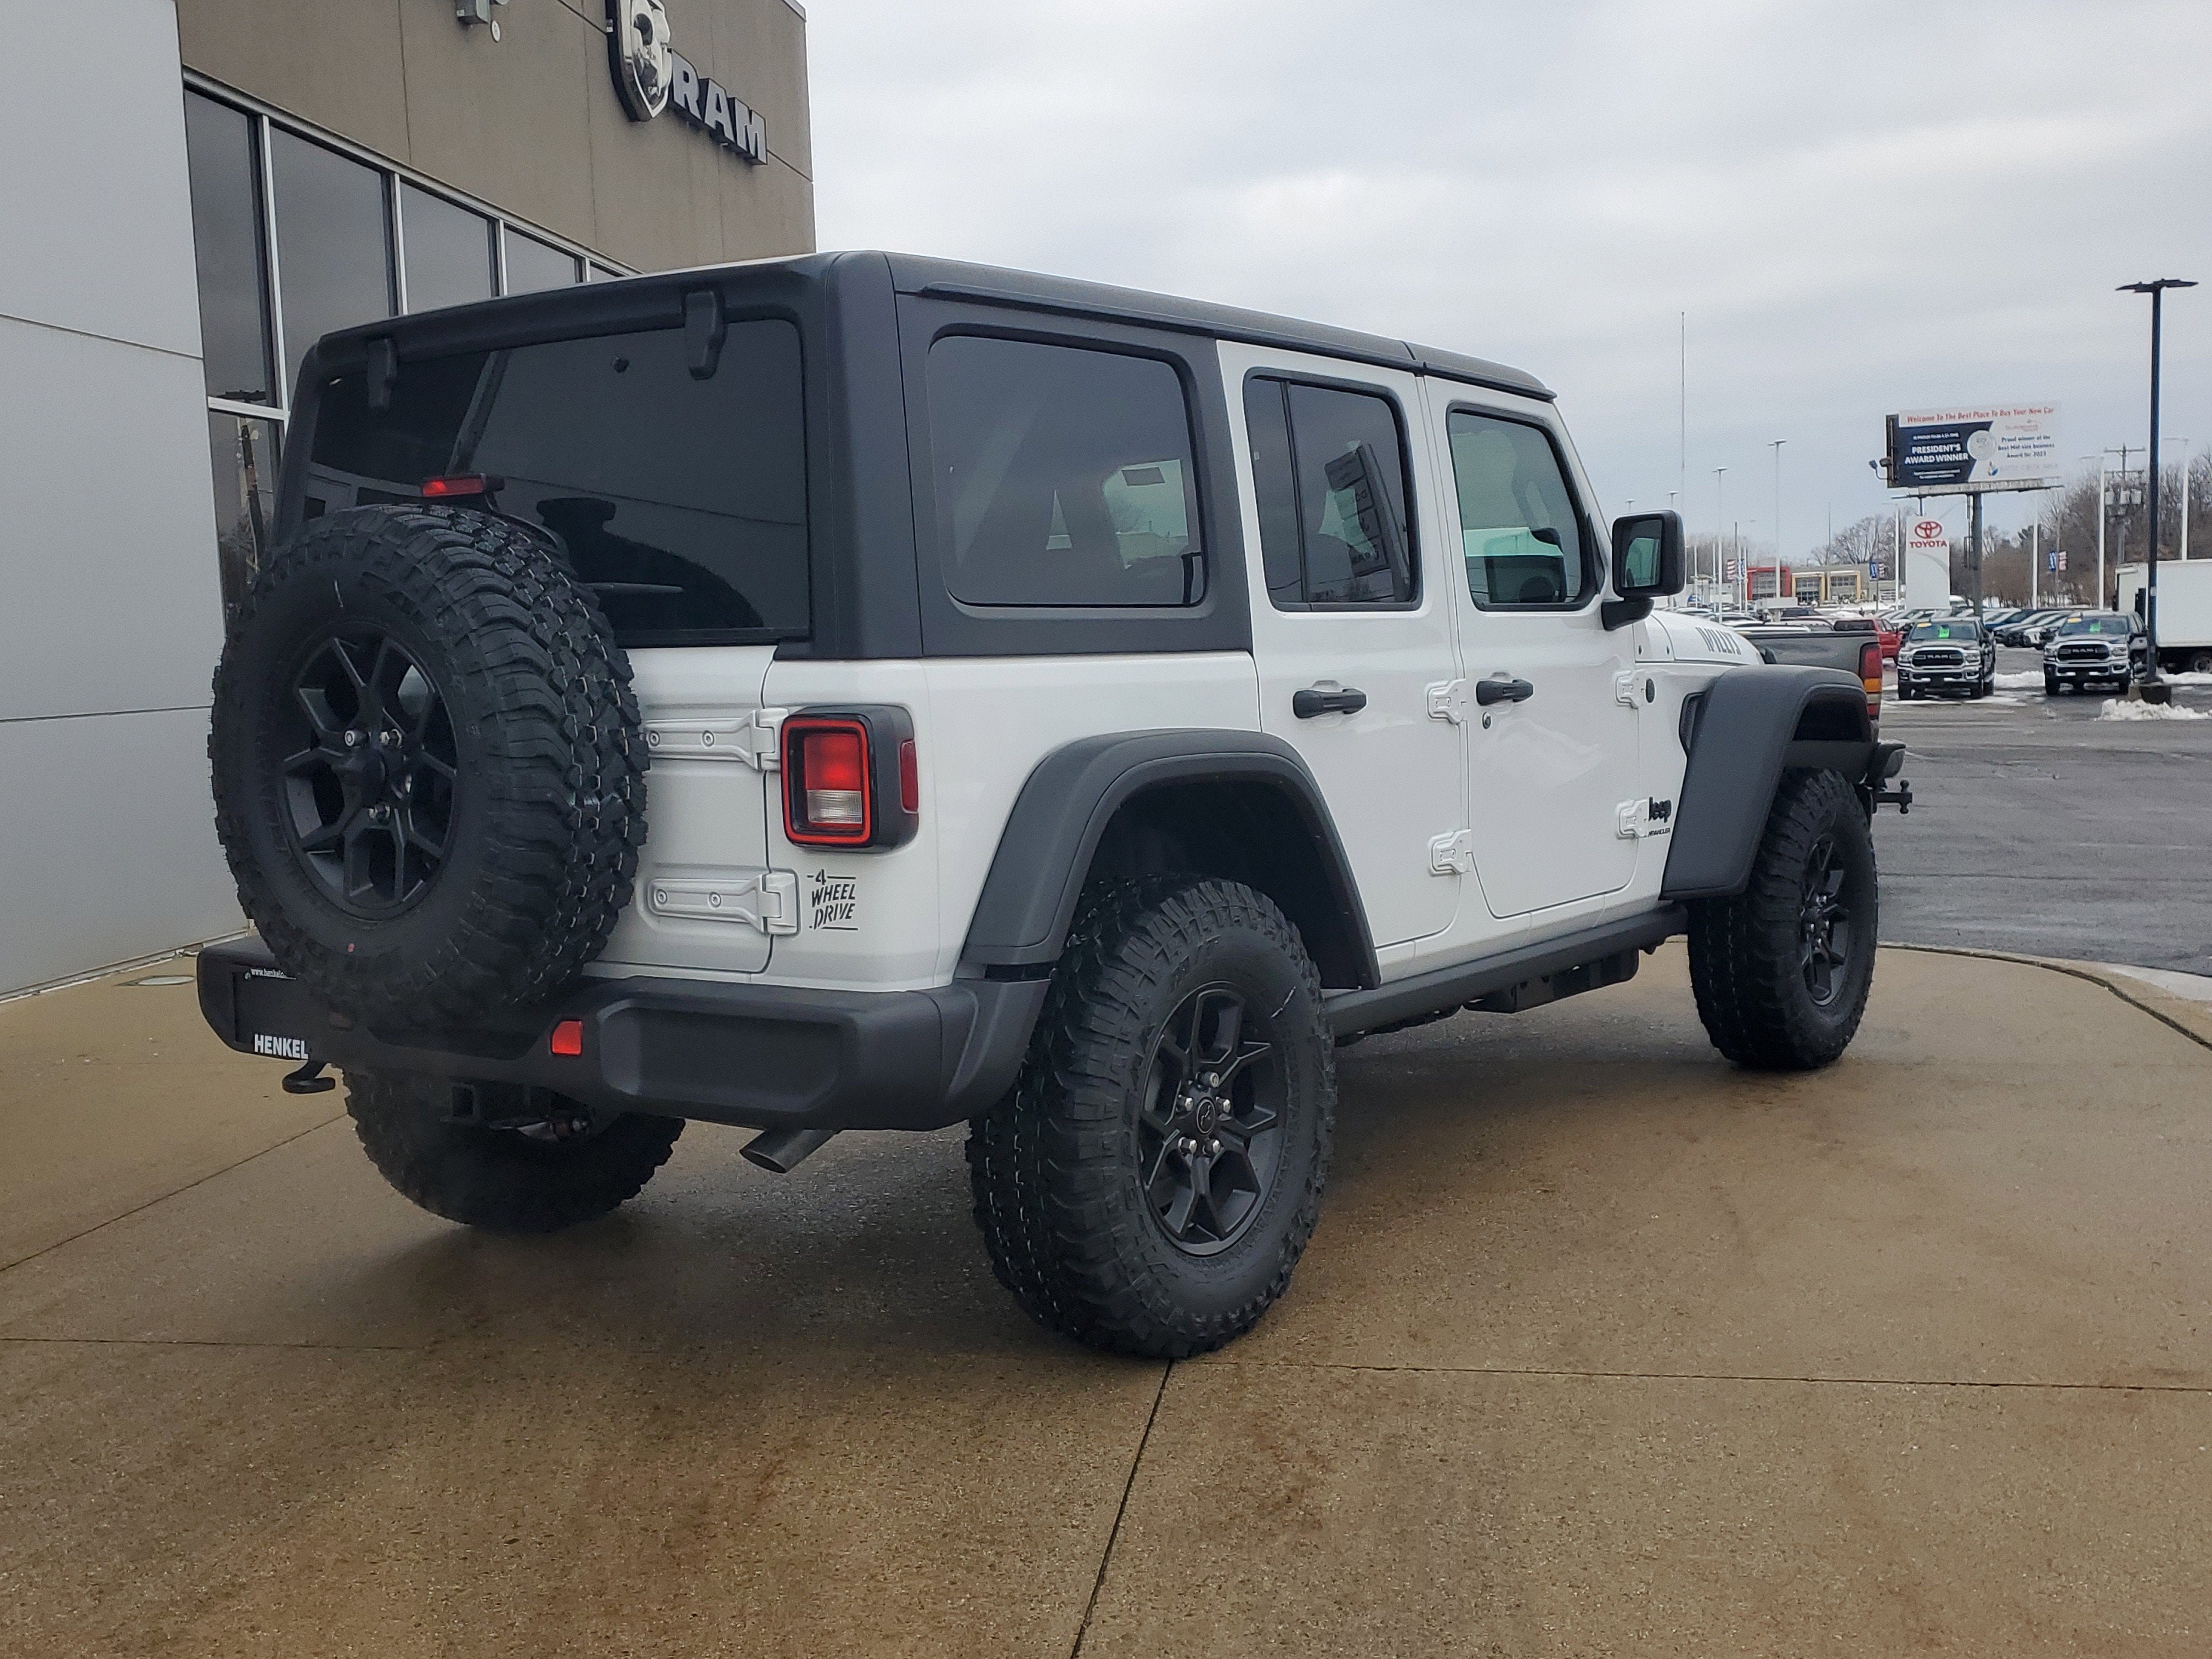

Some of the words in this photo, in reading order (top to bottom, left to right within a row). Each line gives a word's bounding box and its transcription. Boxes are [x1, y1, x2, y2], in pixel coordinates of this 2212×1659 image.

[672, 48, 767, 165] RAM
[1907, 415, 1935, 423] Welcome
[1973, 410, 1990, 419] Place
[1904, 455, 1936, 465] AWARD
[1936, 452, 1969, 462] WINNER
[1912, 443, 1961, 454] PRESIDENT'S
[1909, 540, 1947, 548] TOYOTA
[1695, 626, 1742, 656] WILLYS
[1648, 797, 1672, 823] Jeep
[815, 868, 826, 885] 4
[811, 883, 856, 908] WHEEL
[813, 903, 856, 930] DRIVE
[254, 1034, 309, 1060] HENKEL
